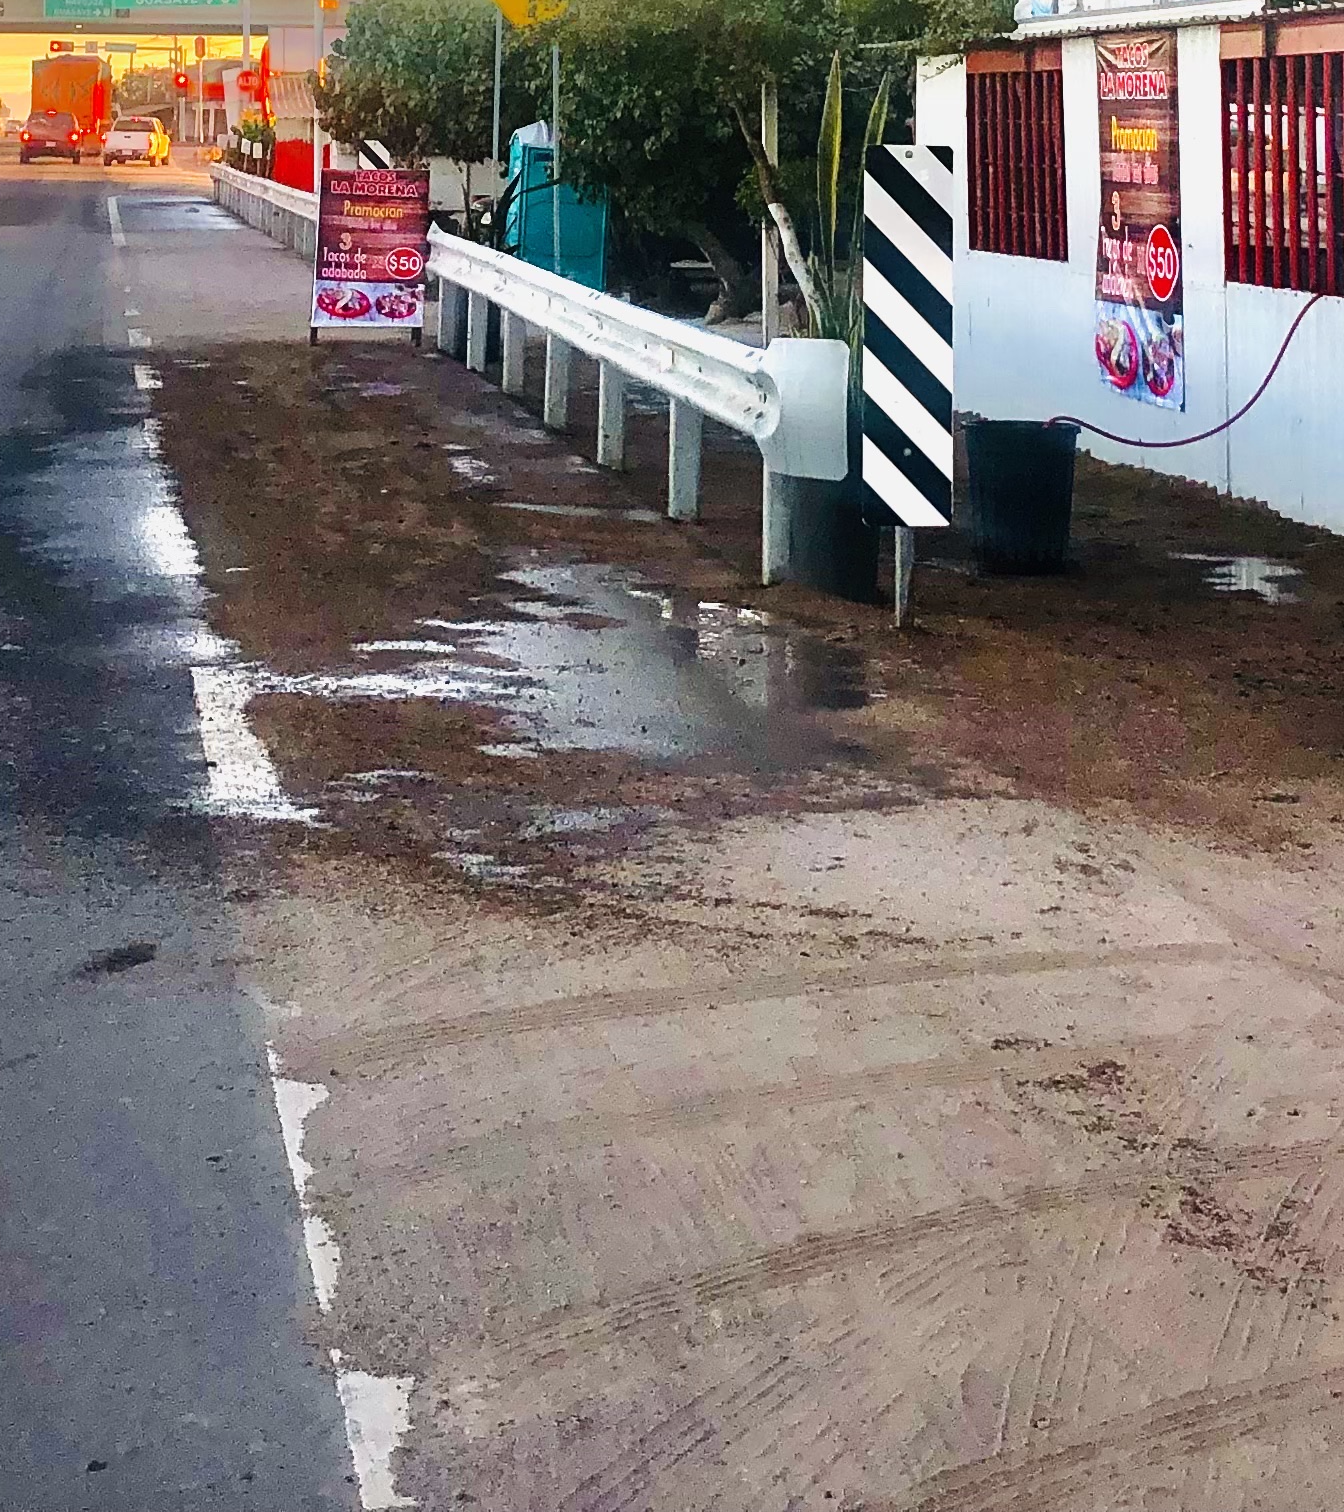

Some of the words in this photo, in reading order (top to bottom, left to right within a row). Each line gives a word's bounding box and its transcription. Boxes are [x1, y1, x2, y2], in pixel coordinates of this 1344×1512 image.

[1115, 42, 1149, 69] TACOS
[238, 76, 258, 86] ALTO
[1100, 72, 1116, 100] LA
[1116, 71, 1168, 100] MORENA
[355, 171, 397, 183] TACOS
[331, 180, 350, 194] LA
[352, 182, 419, 198] MORENA
[1111, 190, 1121, 231] 3
[339, 232, 353, 251] 3
[323, 246, 351, 263] Tacos
[354, 248, 367, 264] de
[389, 254, 420, 272] $50
[1148, 241, 1175, 281] $50
[321, 261, 367, 280] adobada
